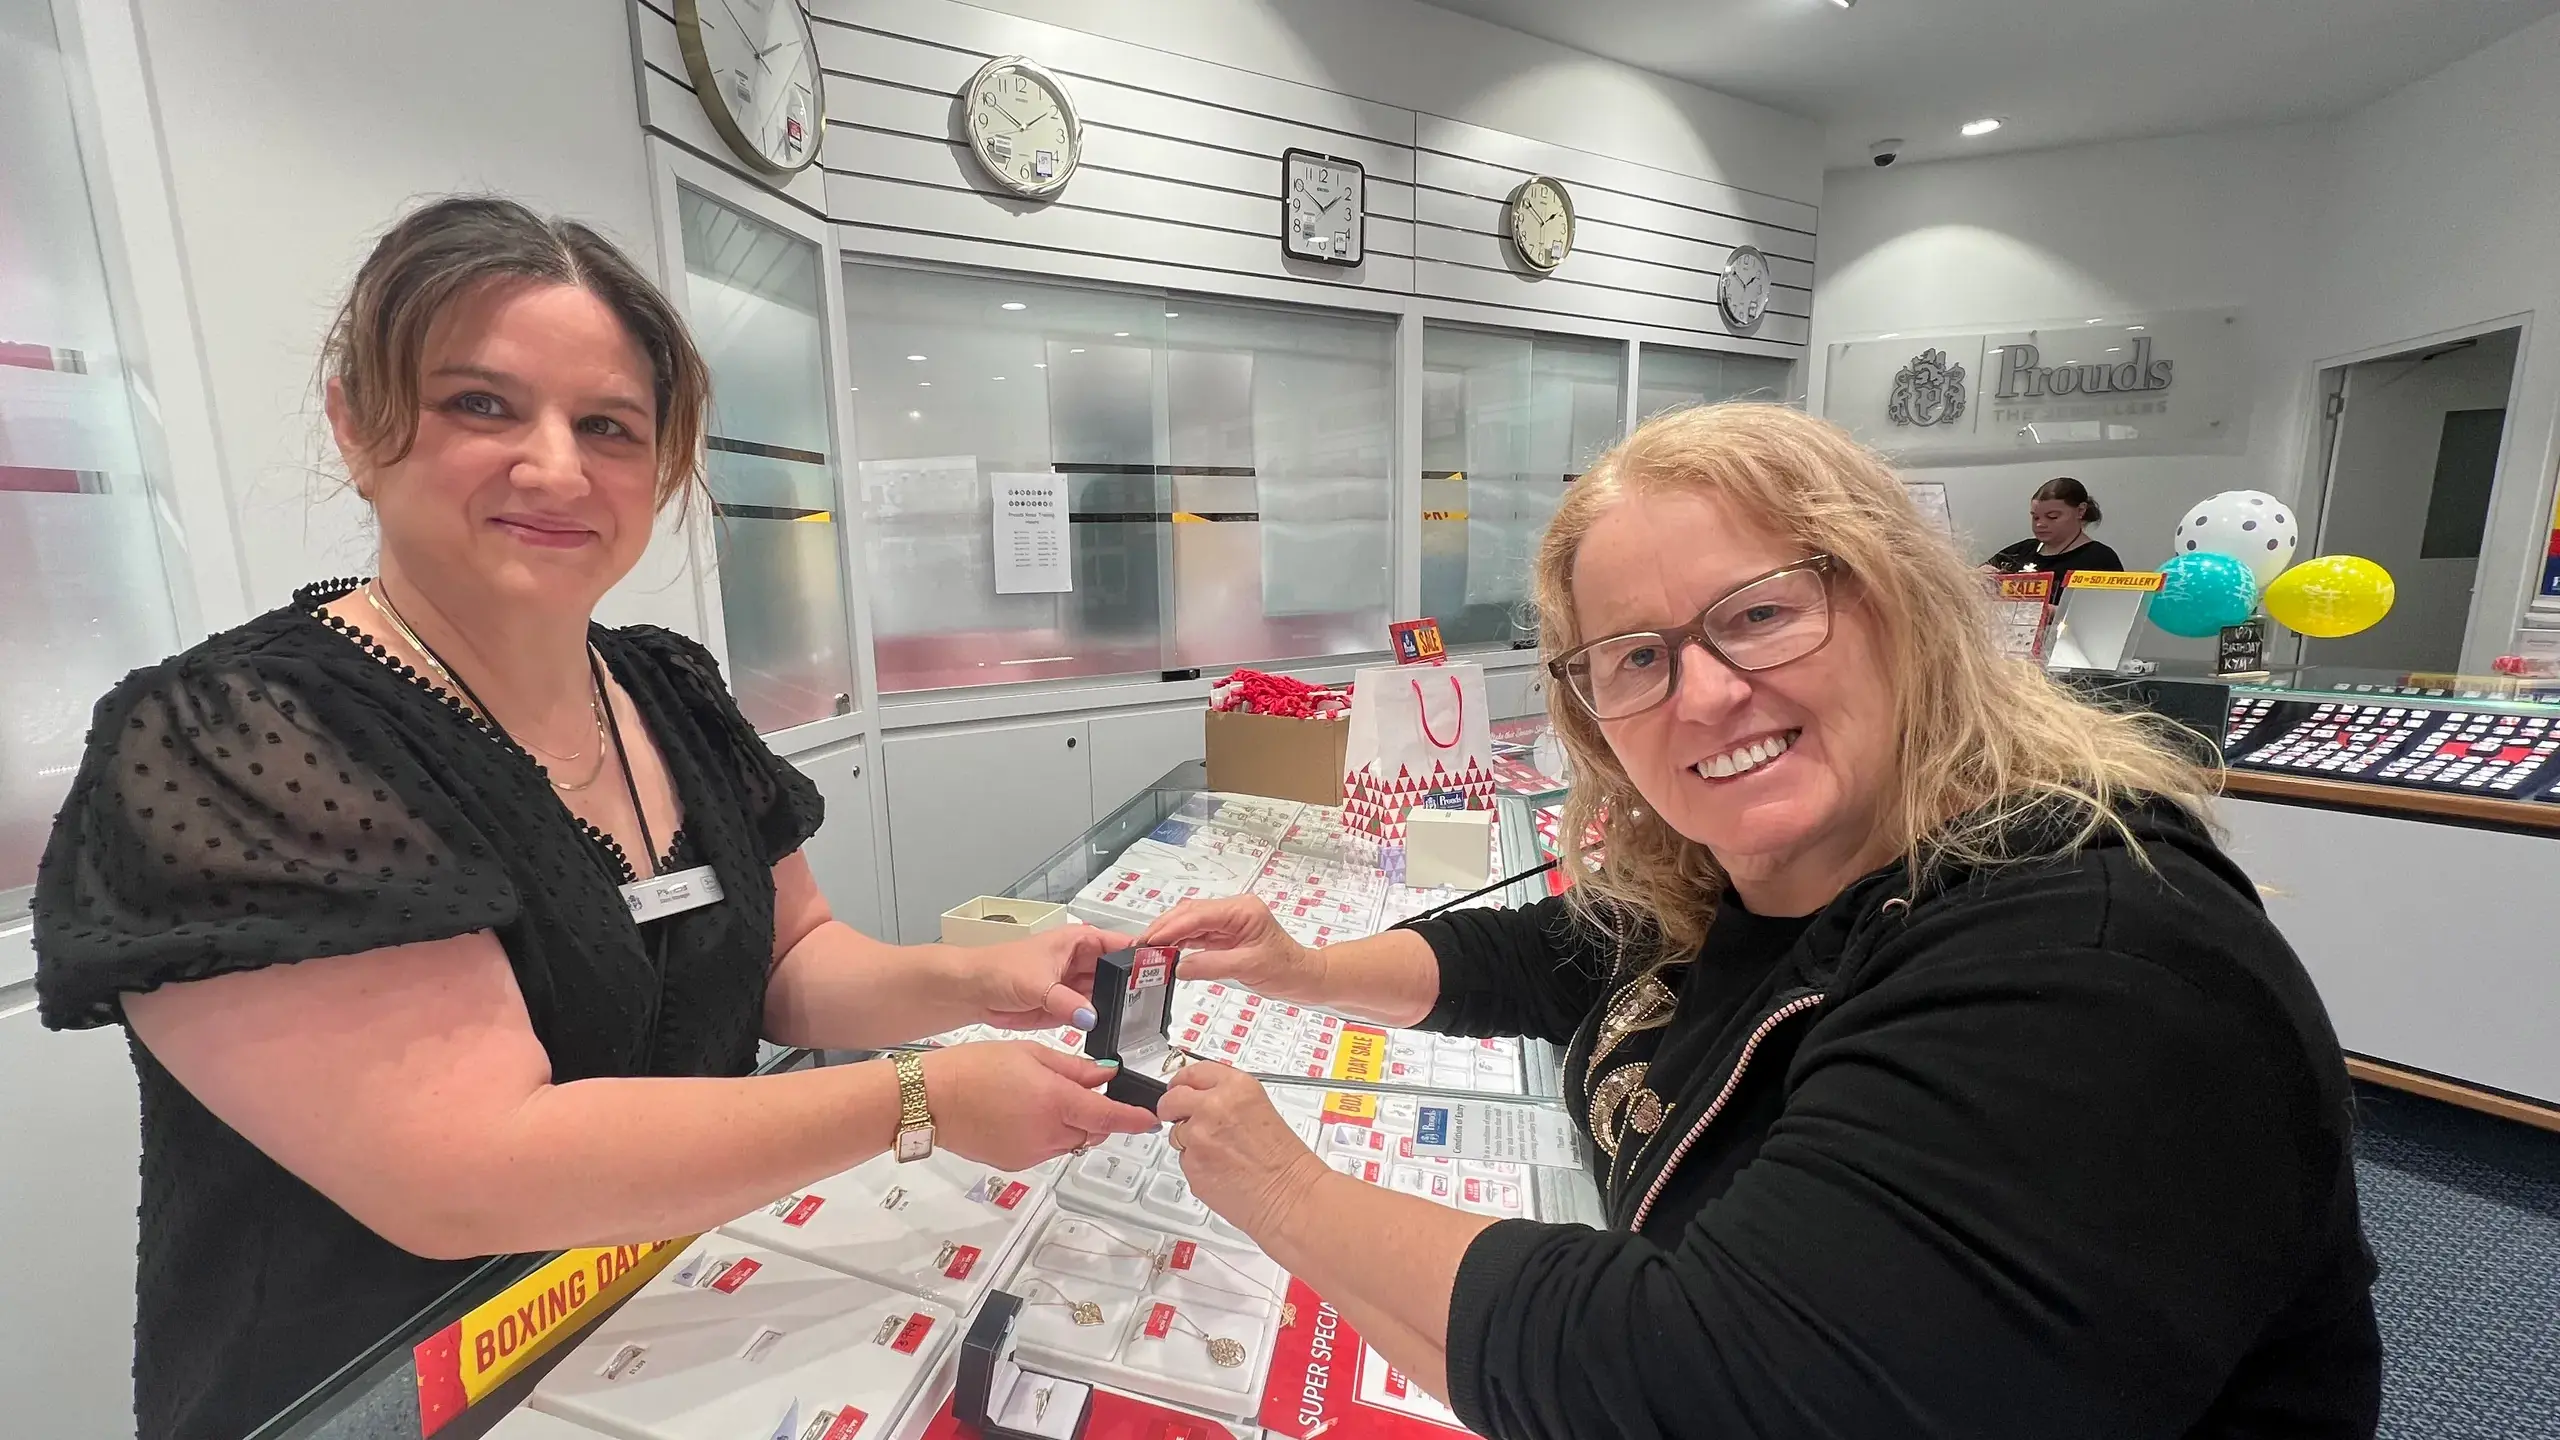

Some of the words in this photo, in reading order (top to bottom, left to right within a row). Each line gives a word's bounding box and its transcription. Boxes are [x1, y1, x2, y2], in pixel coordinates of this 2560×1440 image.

[1015, 77, 1027, 94] 12
[1049, 104, 1059, 120] 2
[978, 112, 989, 129] 9
[1055, 128, 1065, 144] 3
[986, 136, 996, 153] 8
[1019, 163, 1030, 180] 6
[1318, 168, 1329, 184] 12
[1344, 186, 1352, 202] 2
[1292, 197, 1301, 213] 9
[1343, 207, 1352, 222] 3
[1292, 218, 1302, 233] 8
[1559, 222, 1566, 236] 3
[1528, 243, 1535, 256] 7
[1995, 336, 2173, 398] Prouds
[1993, 408, 2034, 422] THE
[2007, 580, 2043, 595] SALE
[2071, 575, 2084, 584] 30
[2106, 576, 2160, 587] JEWELLERY
[1419, 629, 1440, 654] SALE
[2221, 641, 2261, 656] BIRTHDAY
[1439, 793, 1462, 806] Prouds
[1148, 949, 1164, 958] LAST
[1350, 1035, 1373, 1057] SALE
[1346, 1056, 1370, 1075] DAY
[1454, 1103, 1467, 1119] Entry
[1421, 1109, 1437, 1131] Prouds
[1452, 1125, 1463, 1154] Condition
[475, 1268, 586, 1375] BOXING
[595, 1243, 640, 1292] DAY
[1310, 1301, 1339, 1362] SPECIA
[1298, 1362, 1330, 1428] SUPER
